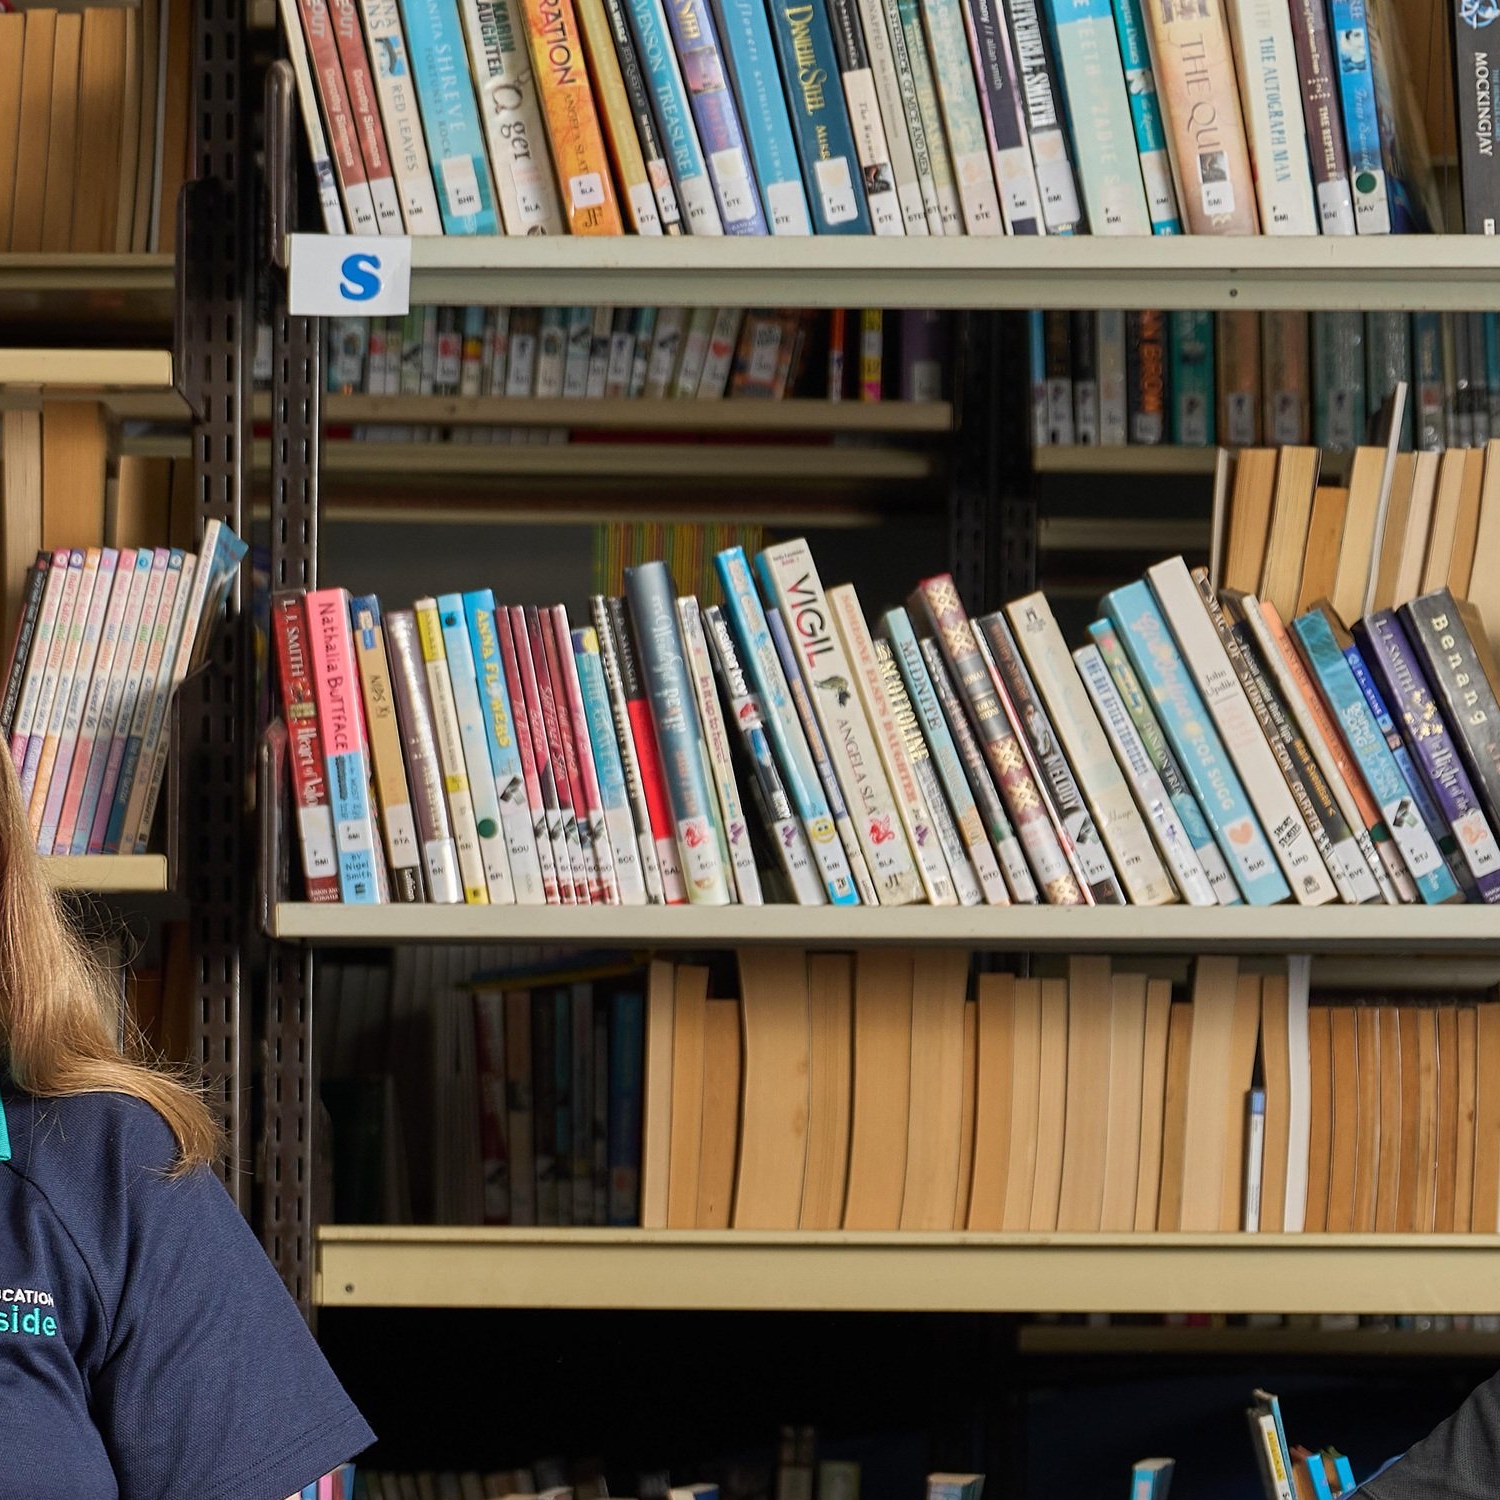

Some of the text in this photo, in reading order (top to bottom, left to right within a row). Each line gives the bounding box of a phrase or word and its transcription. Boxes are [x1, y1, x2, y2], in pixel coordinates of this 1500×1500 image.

[434, 43, 468, 133] SHREVE
[1261, 65, 1288, 146] AUTOGRAPH
[1473, 51, 1495, 158] MOCKINGJAY
[397, 118, 419, 173] LEAVES
[1272, 148, 1293, 184] MAN
[338, 253, 382, 301] S
[317, 600, 337, 677] Nathalia
[476, 609, 495, 658] ANNA
[787, 573, 835, 669] VIGIL
[900, 640, 943, 731] MIDNITE
[1431, 613, 1489, 727] Benang
[1207, 767, 1236, 811] SUGG
